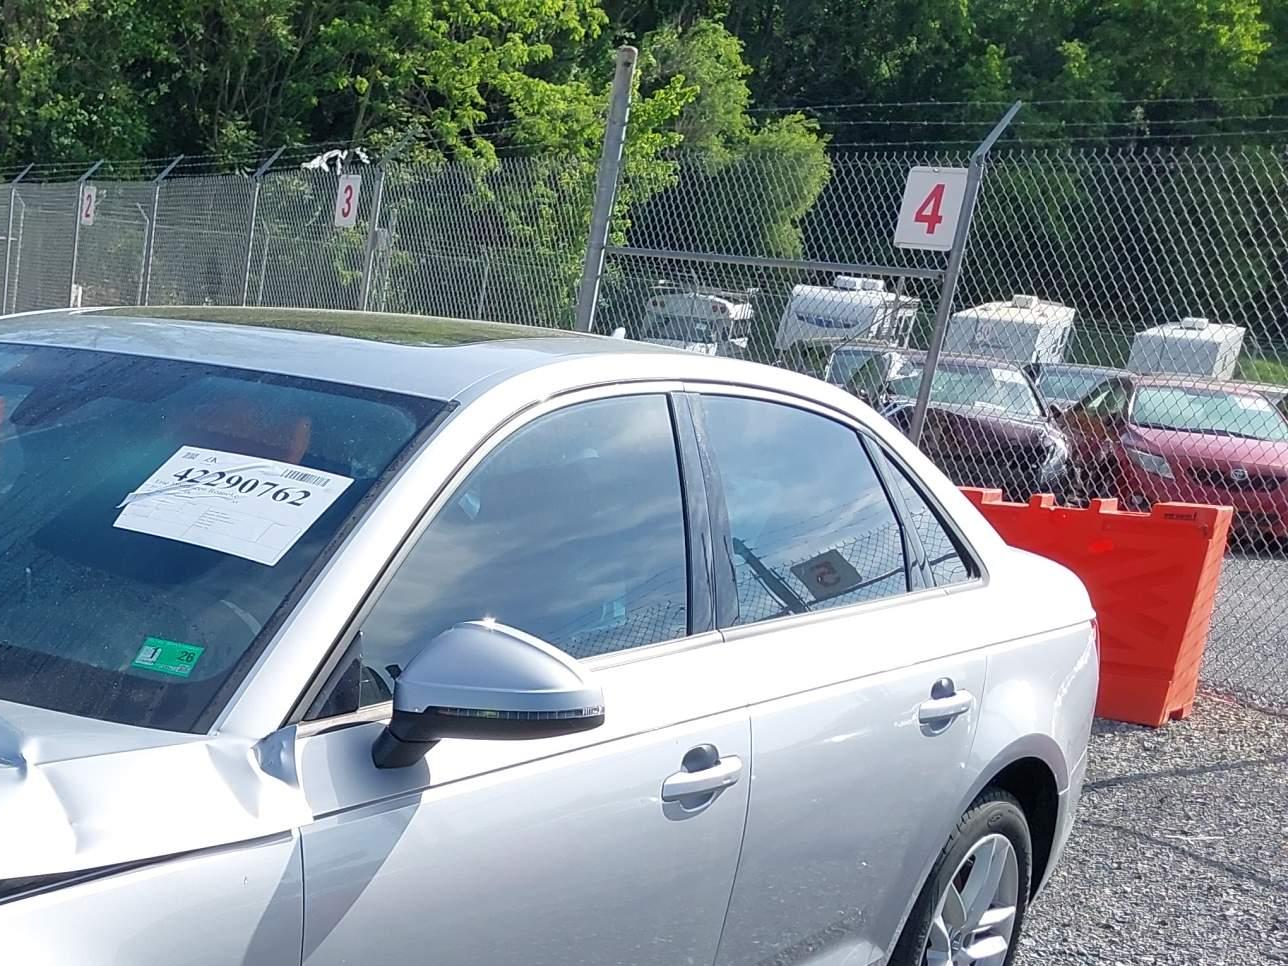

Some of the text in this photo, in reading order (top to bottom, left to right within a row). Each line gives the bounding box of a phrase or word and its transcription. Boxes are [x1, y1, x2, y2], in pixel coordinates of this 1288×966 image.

[84, 193, 92, 218] 2
[341, 184, 353, 218] 3
[914, 183, 945, 234] 4
[173, 467, 312, 507] 42290762
[177, 650, 196, 663] 26
